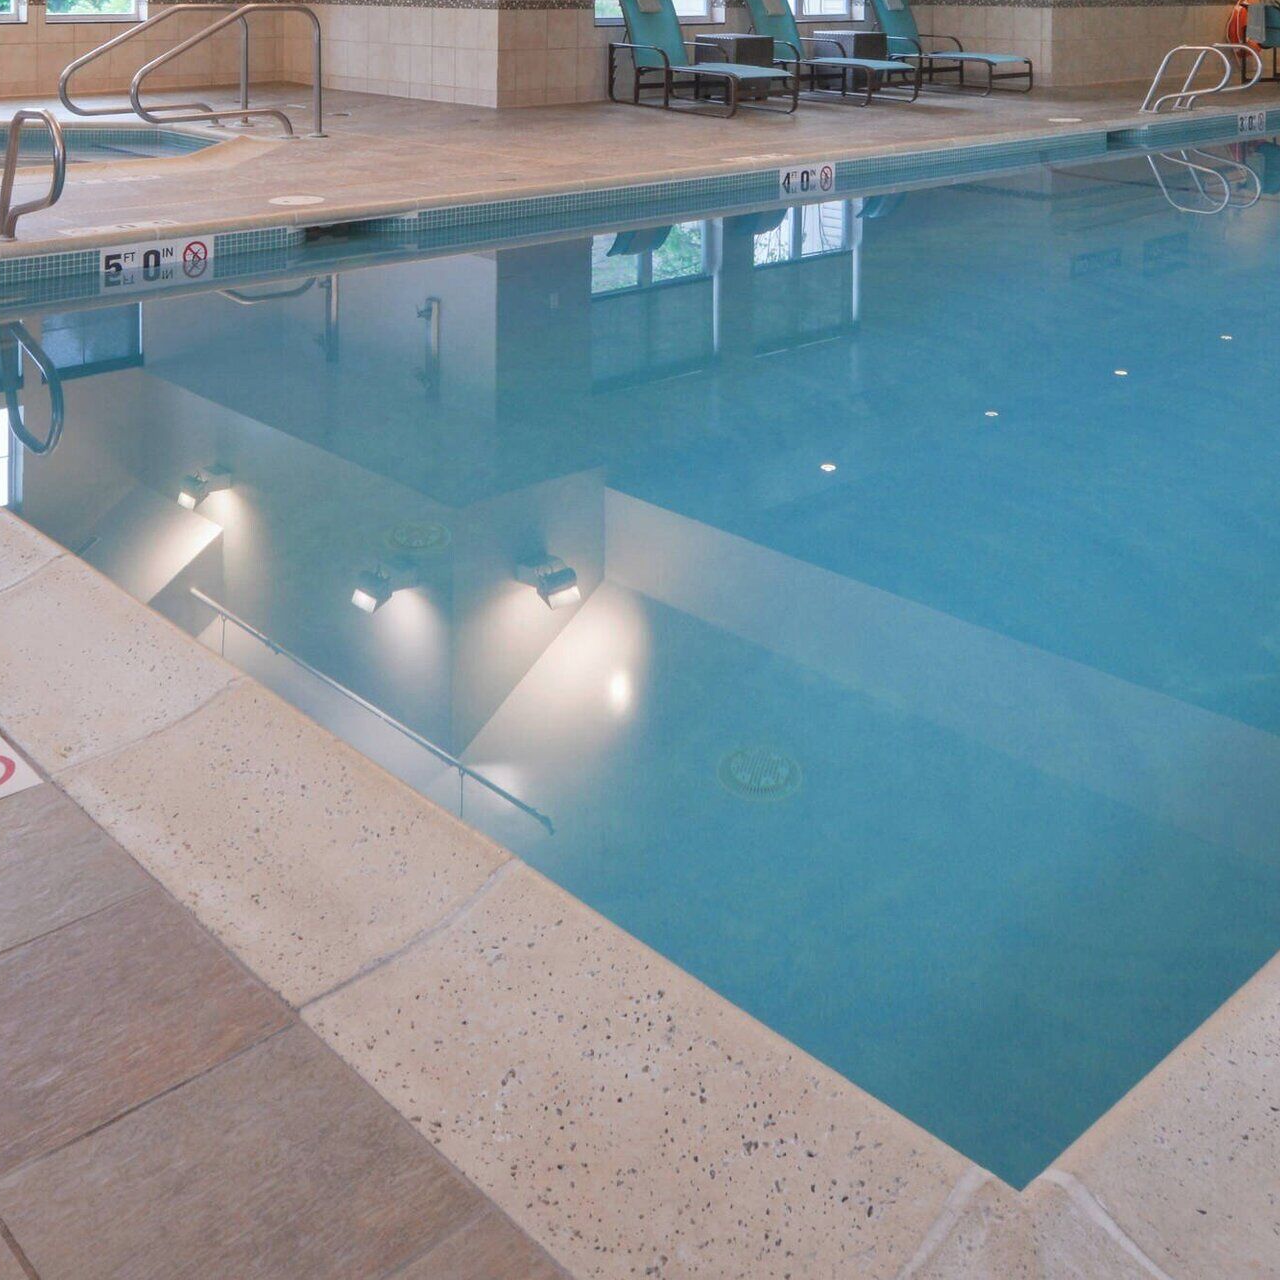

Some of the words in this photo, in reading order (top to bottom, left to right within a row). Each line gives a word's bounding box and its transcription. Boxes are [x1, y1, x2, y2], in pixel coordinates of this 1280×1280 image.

[104, 253, 122, 276] 5
[123, 252, 136, 263] FT
[143, 249, 161, 279] 0
[162, 247, 174, 258] IN
